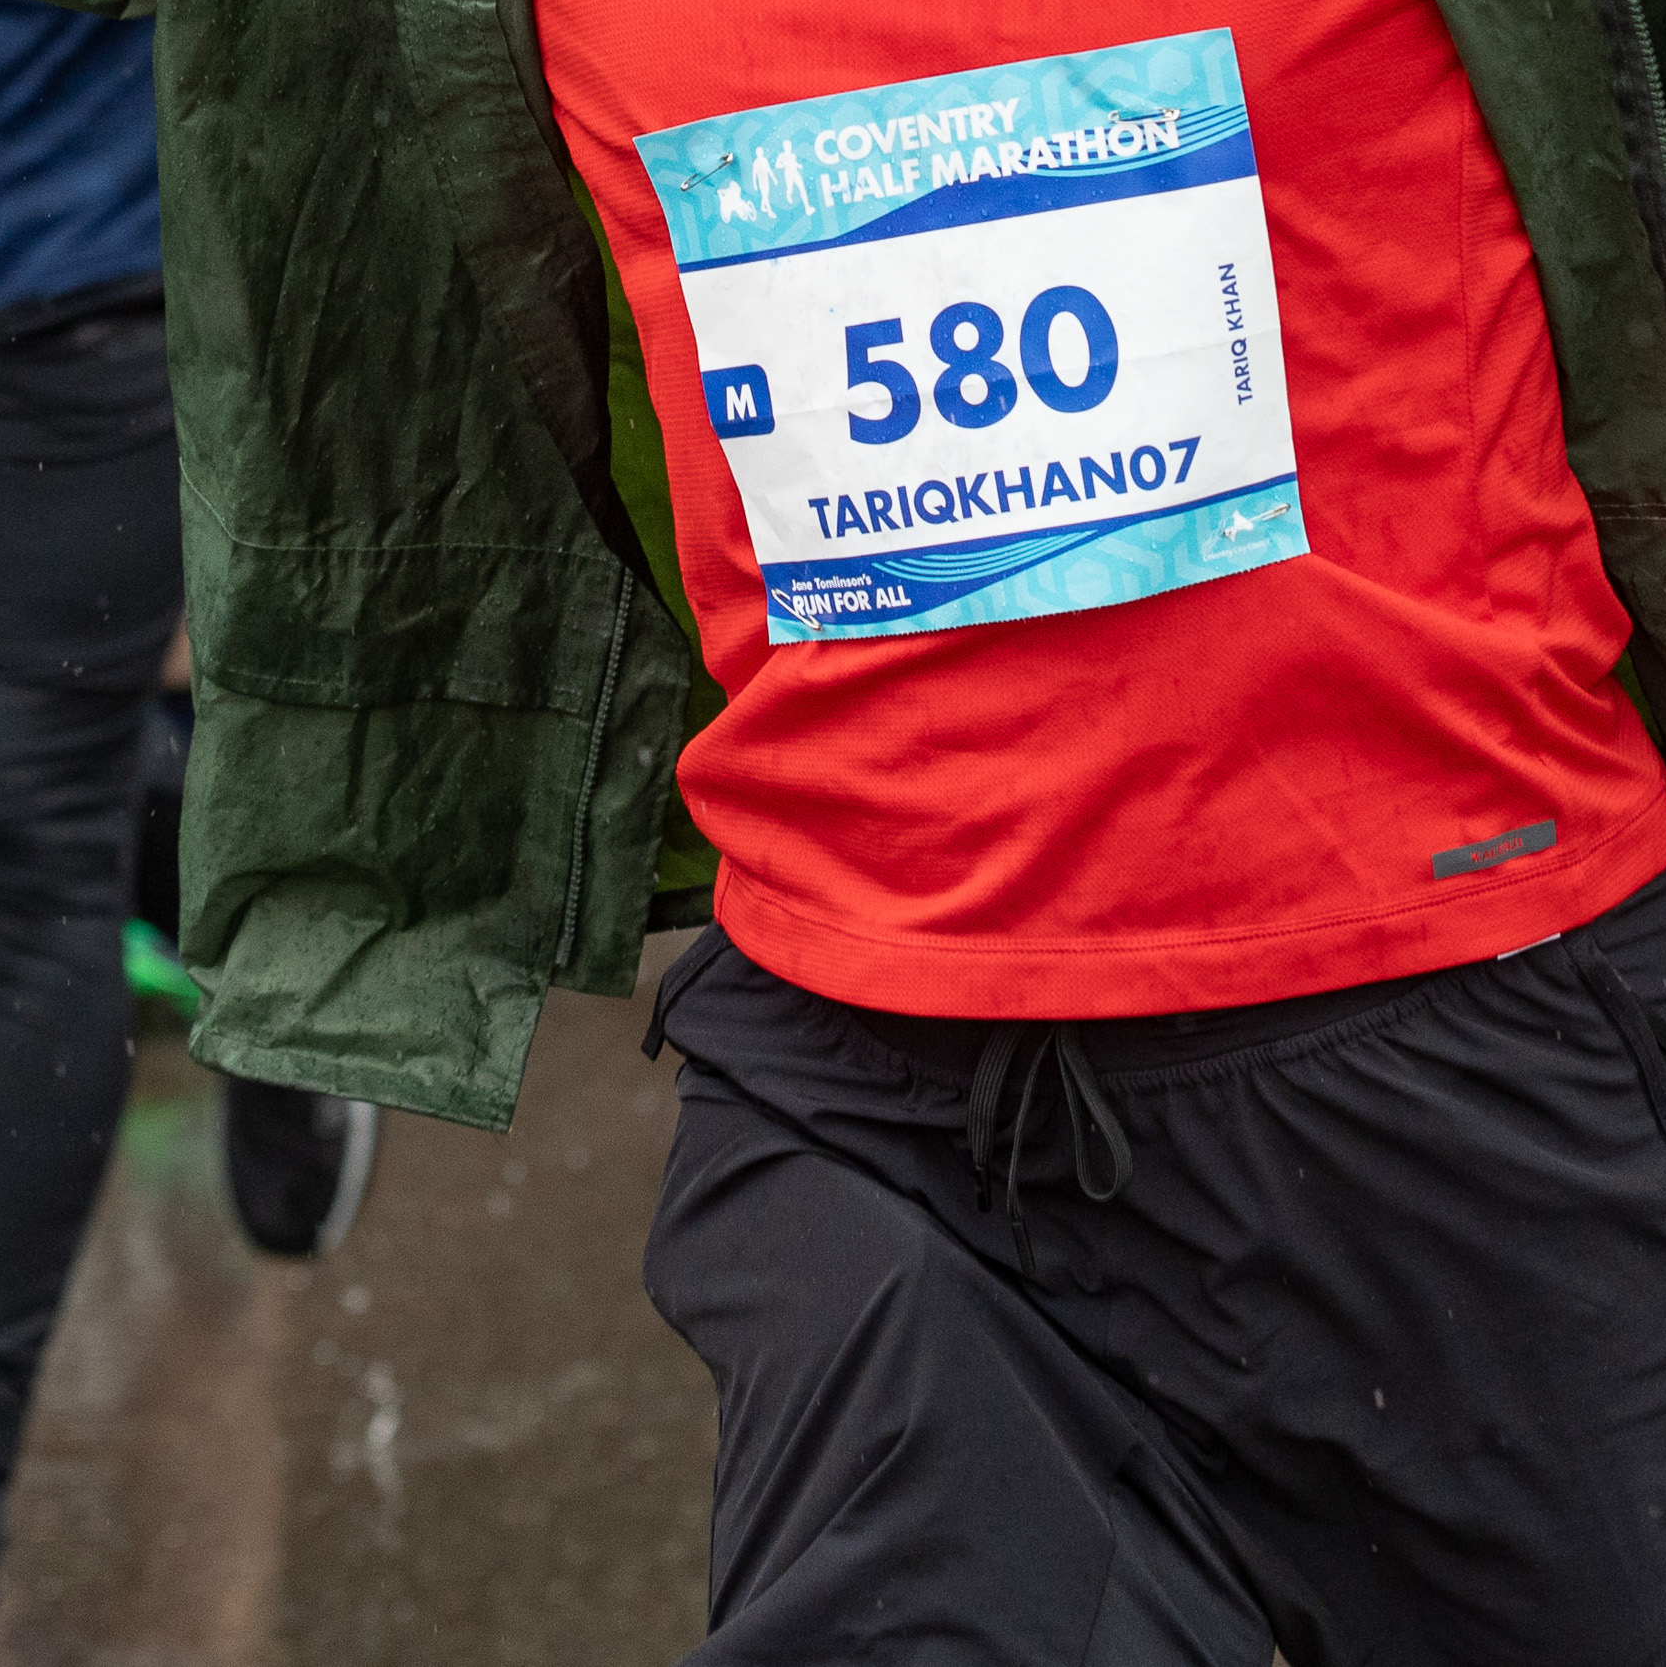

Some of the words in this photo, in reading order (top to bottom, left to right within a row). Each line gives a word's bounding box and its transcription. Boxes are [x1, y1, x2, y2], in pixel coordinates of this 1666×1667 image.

[814, 98, 1020, 165] COVENTRY
[820, 158, 921, 207] HALF
[931, 117, 1180, 186] MARATHON
[1218, 263, 1244, 331] KHAN
[844, 285, 1119, 445] 580
[1231, 337, 1253, 406] TARIQ
[724, 385, 757, 422] M
[808, 435, 1202, 539] TARIQKHAN07
[791, 579, 813, 592] Jane
[814, 573, 872, 590] Tomlinson's
[792, 593, 833, 617] RUN
[833, 590, 872, 613] FOR
[876, 585, 912, 609] ALL
